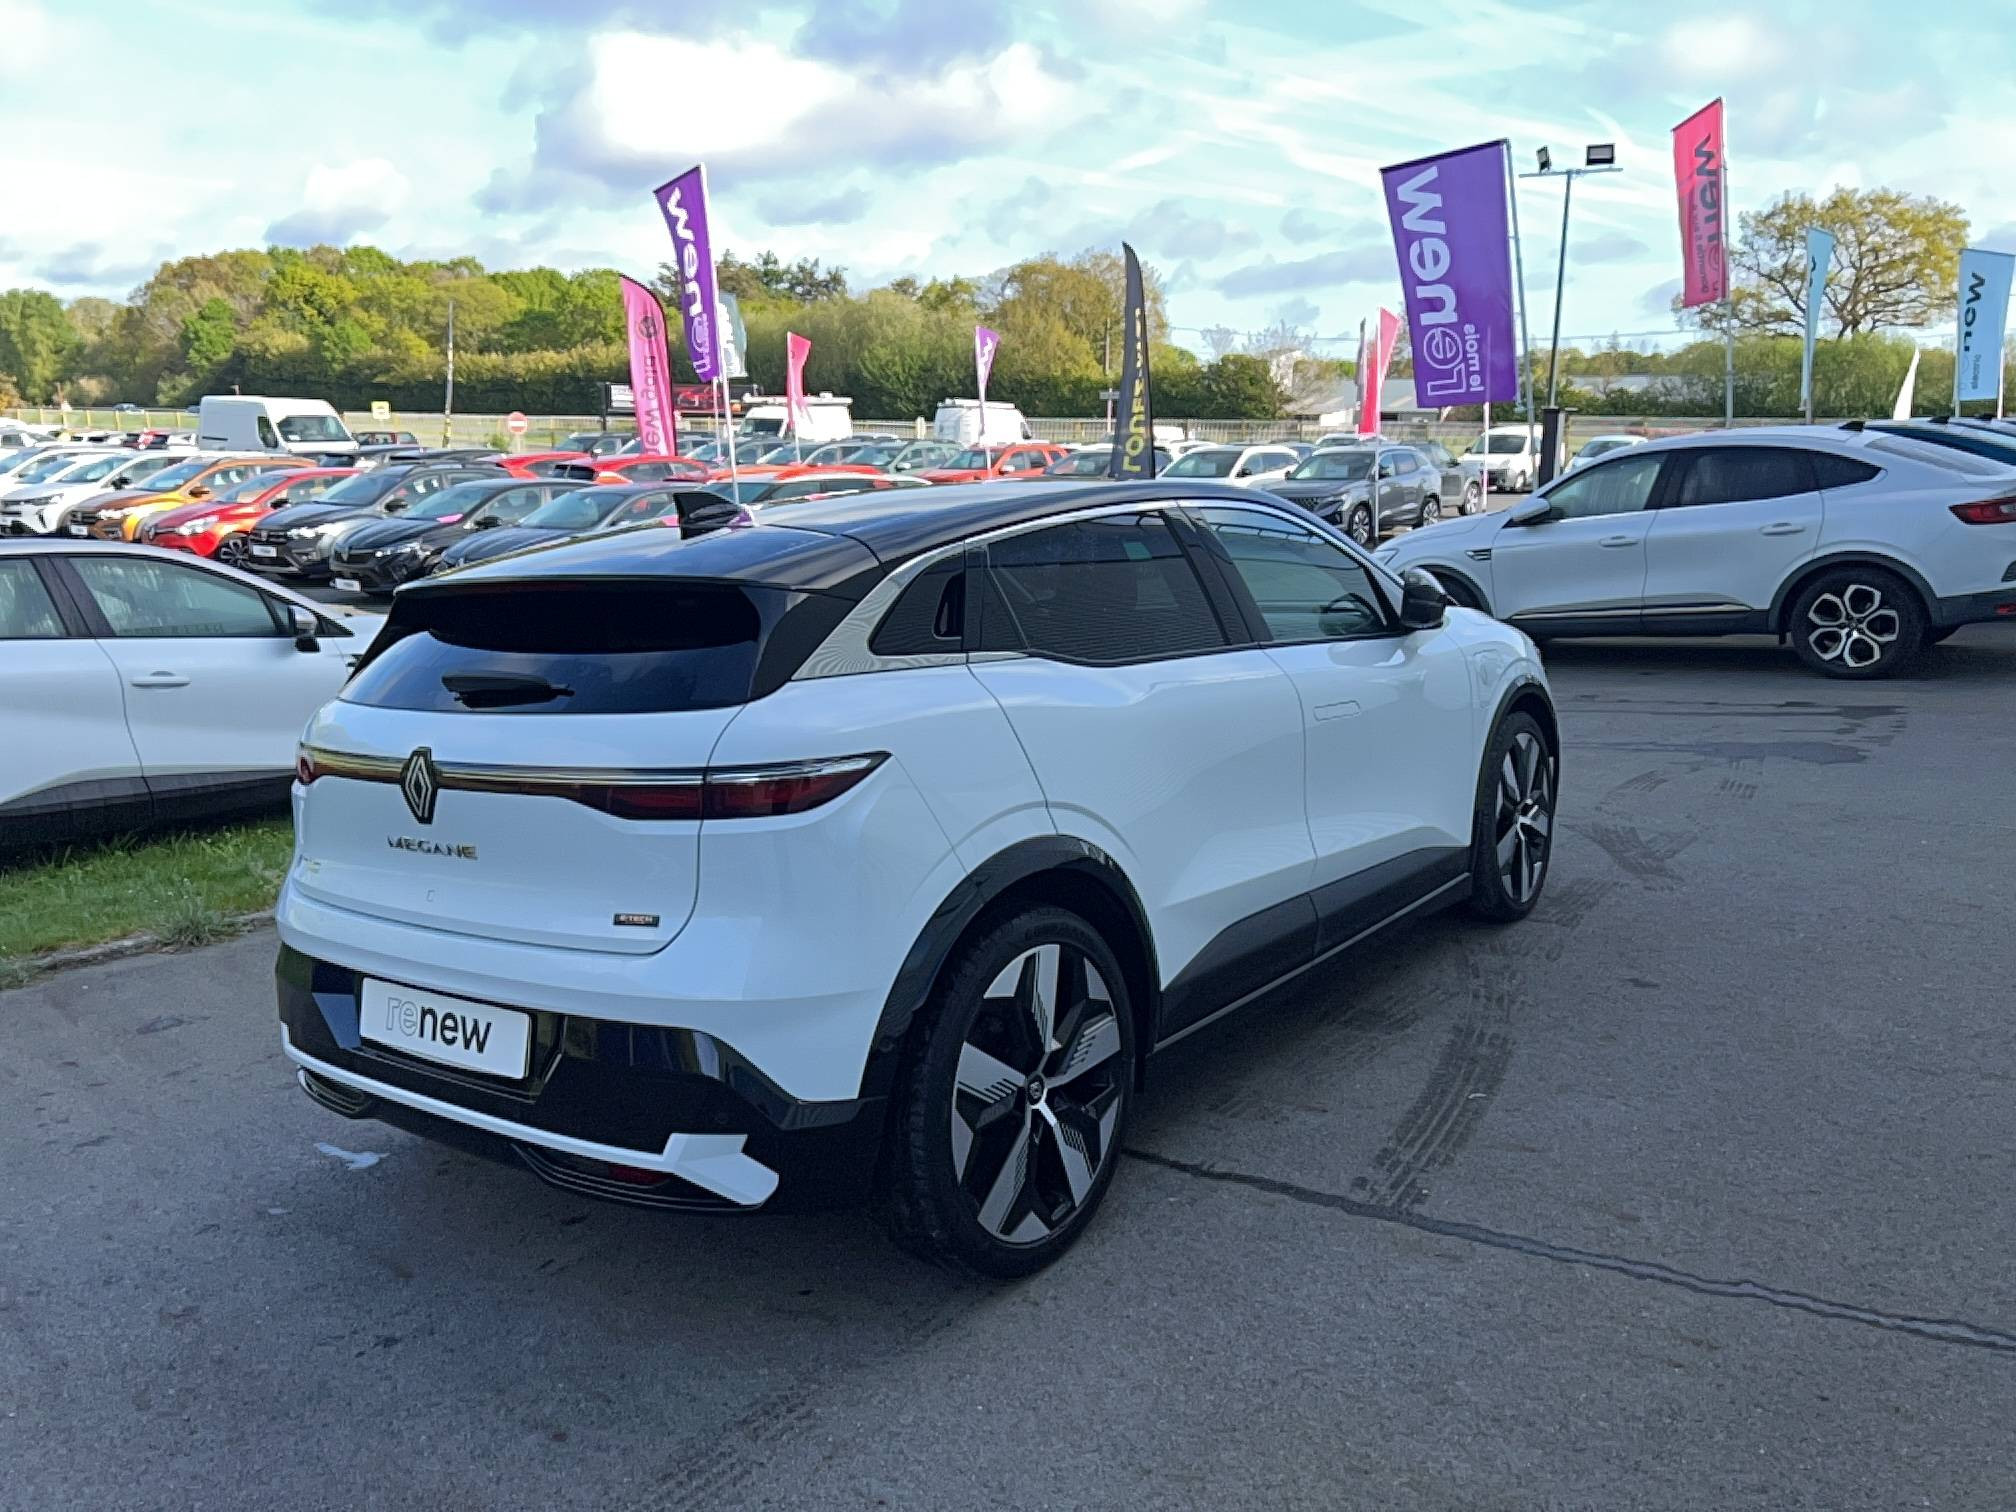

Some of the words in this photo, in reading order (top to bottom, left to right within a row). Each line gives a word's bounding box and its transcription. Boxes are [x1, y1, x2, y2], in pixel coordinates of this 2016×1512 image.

[1960, 272, 1986, 391] new
[386, 835, 479, 861] MEGANE
[386, 997, 492, 1054] renew
